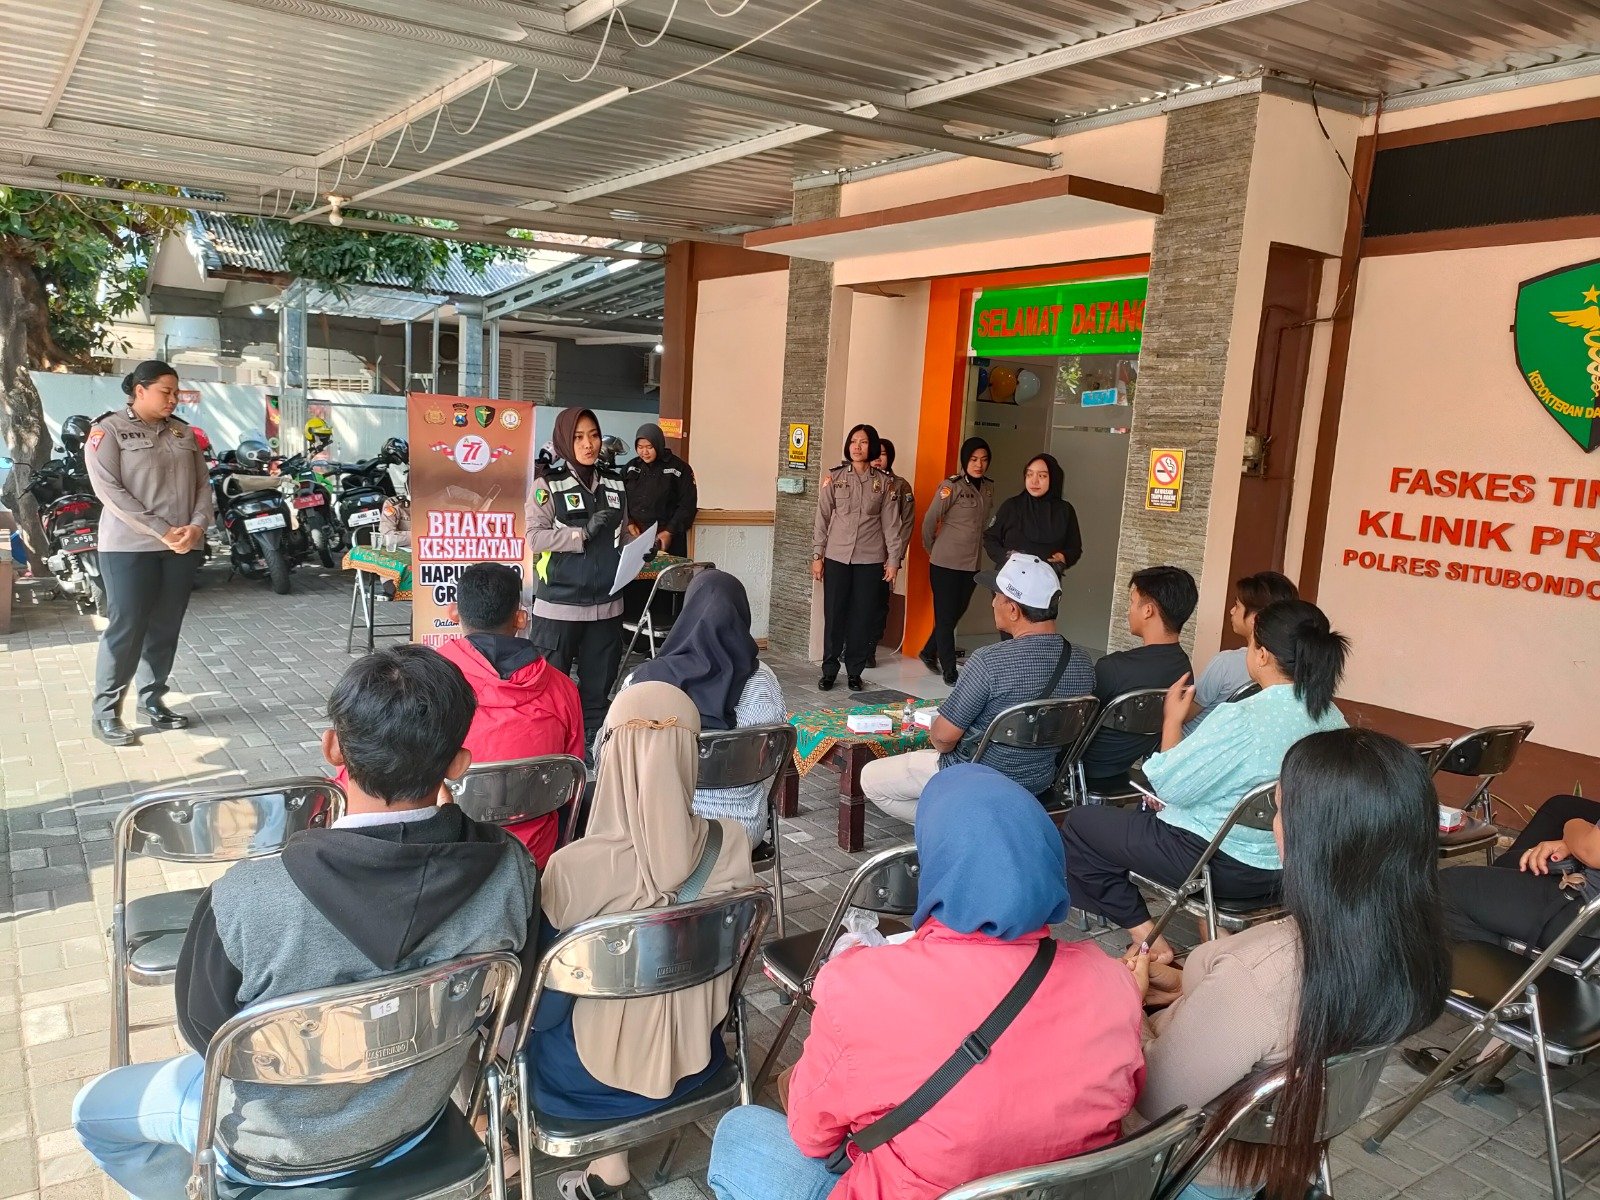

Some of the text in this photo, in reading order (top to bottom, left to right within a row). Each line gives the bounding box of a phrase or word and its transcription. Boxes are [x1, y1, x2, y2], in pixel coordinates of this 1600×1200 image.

[978, 305, 1063, 338] SELAMAT
[1528, 370, 1584, 417] KEDOKTERAN
[121, 432, 146, 440] DEVI
[462, 442, 483, 462] 77
[1390, 467, 1536, 504] FASKES
[428, 511, 515, 538] BHAKTI
[1358, 509, 1515, 552] KLINIK
[419, 537, 524, 560] KESEHATAN
[421, 565, 467, 583] HAPU
[1342, 549, 1600, 600] POLRES SITUBONDO
[422, 634, 440, 646] HUT
[379, 1003, 392, 1015] 15
